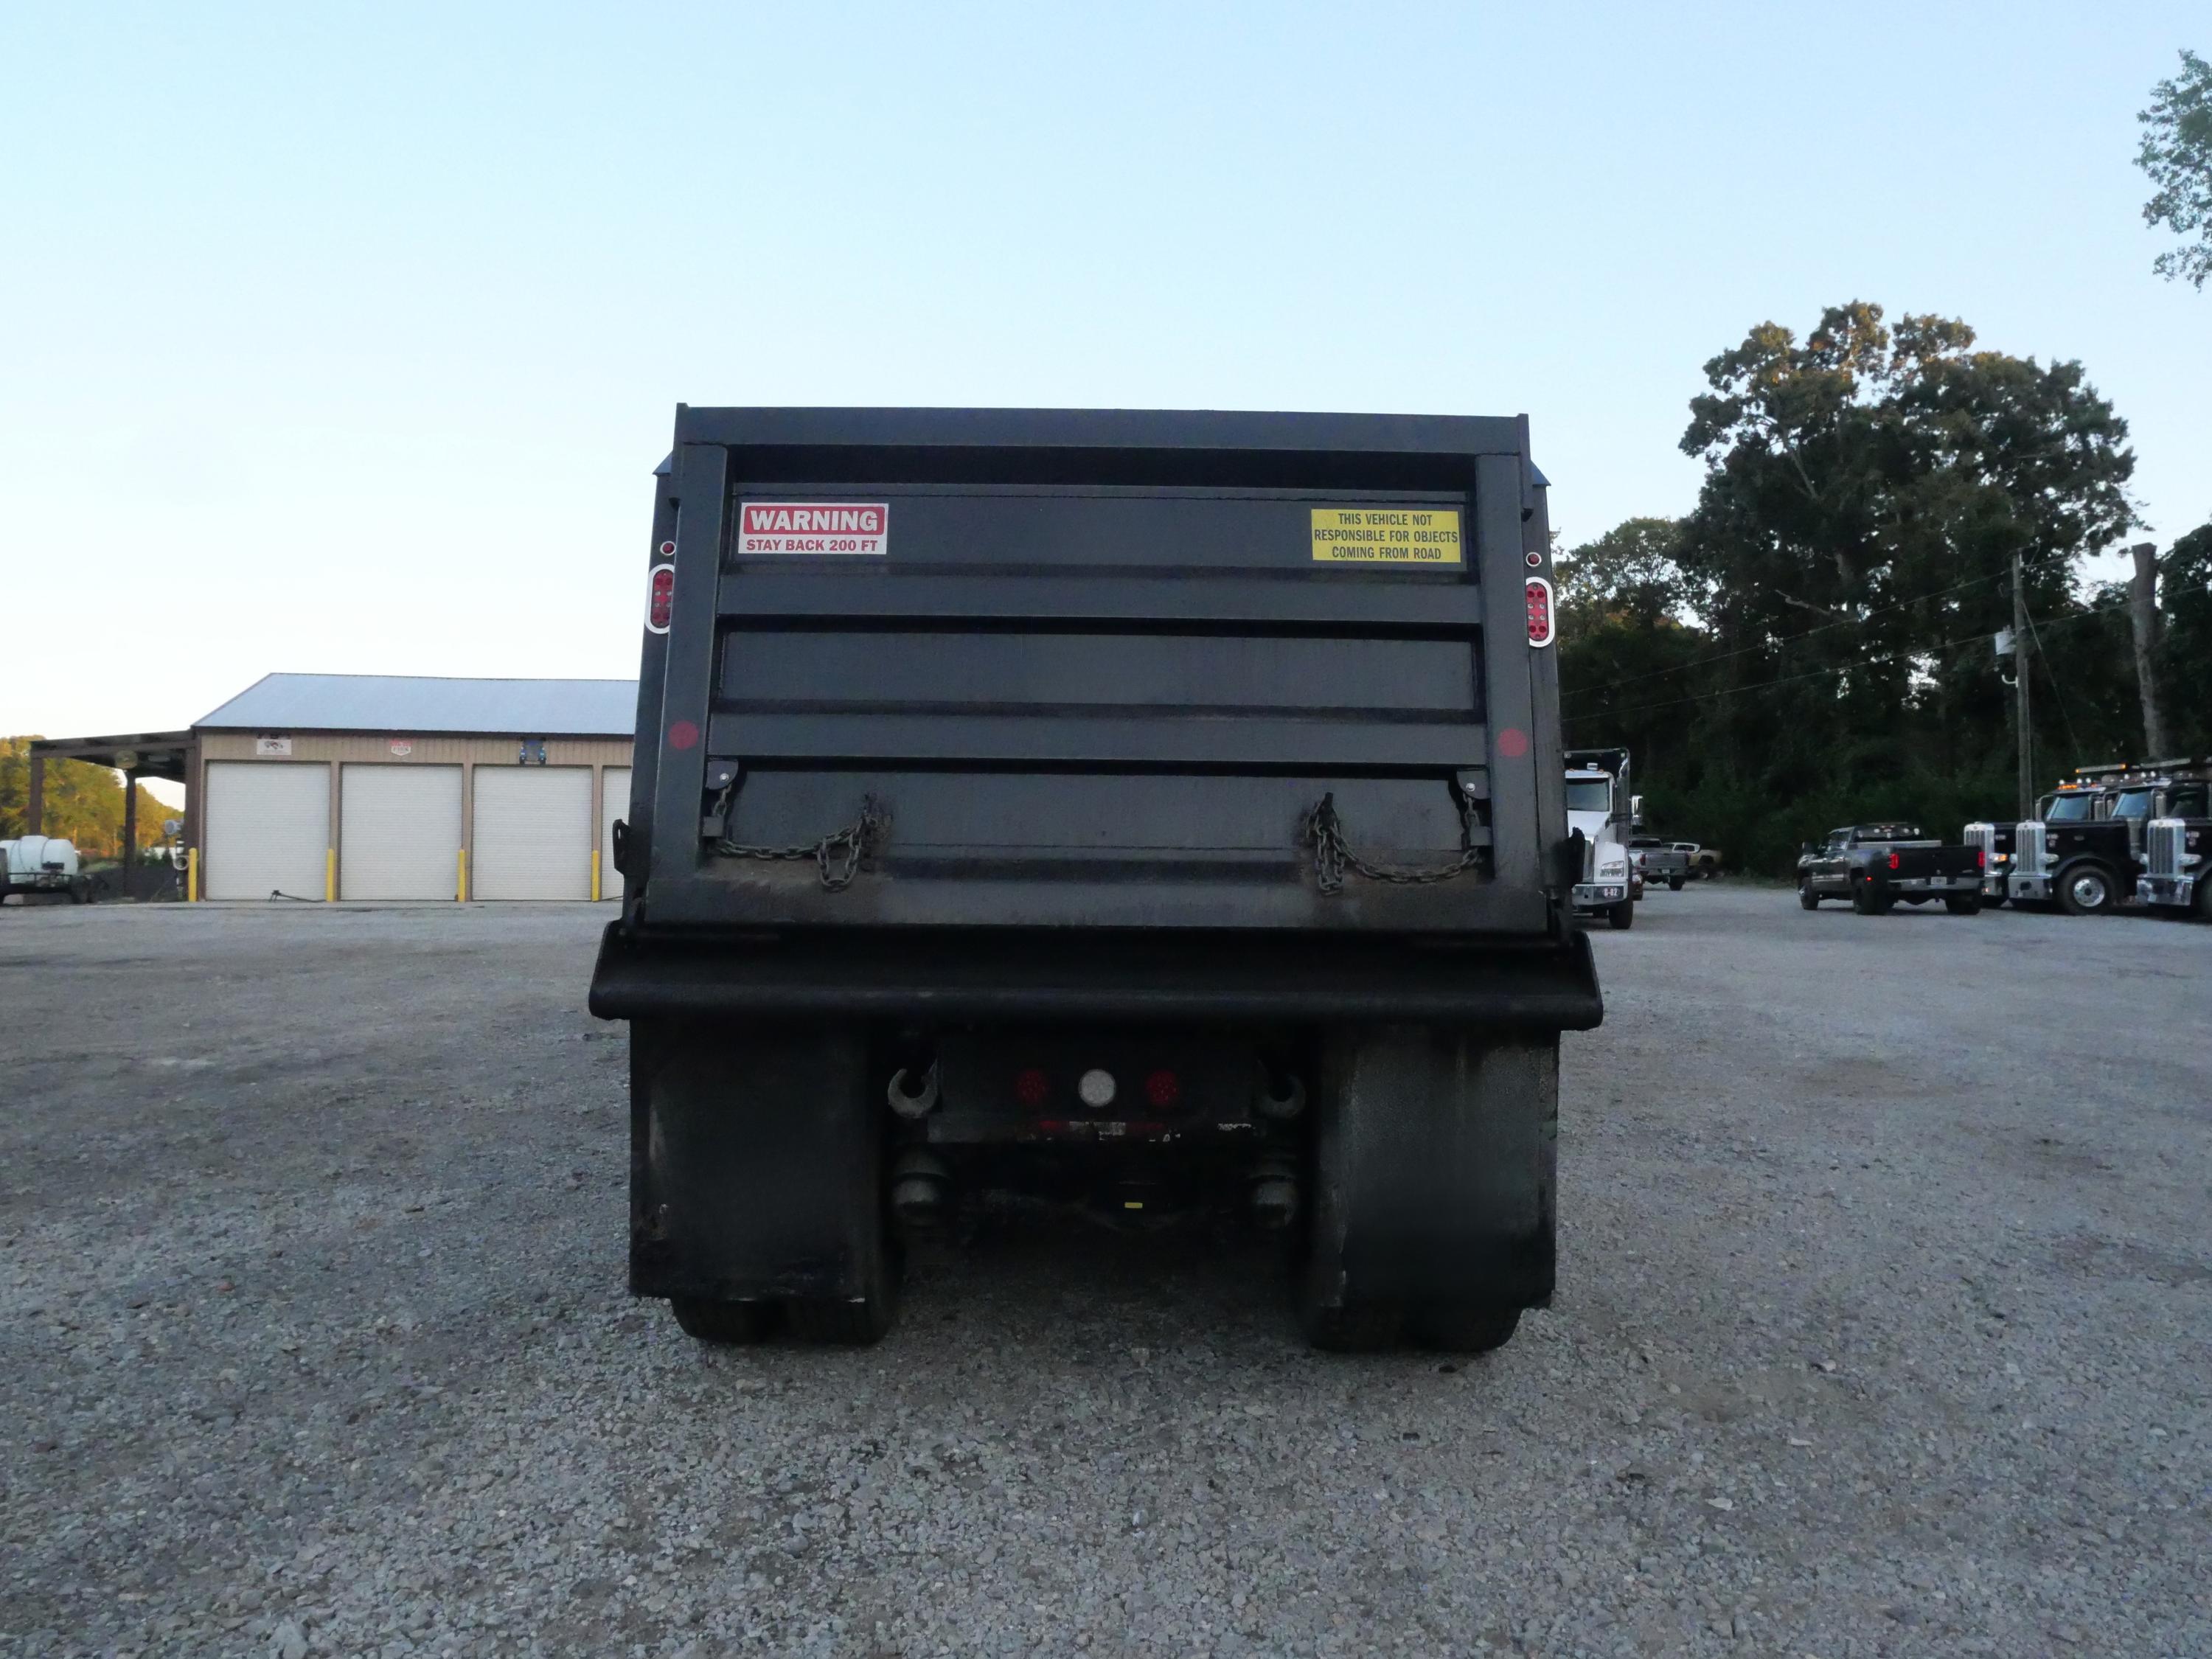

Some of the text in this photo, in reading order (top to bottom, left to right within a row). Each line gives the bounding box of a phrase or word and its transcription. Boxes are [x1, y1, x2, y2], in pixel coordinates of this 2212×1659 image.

[750, 510, 877, 531] WARNING
[1338, 513, 1432, 526] THIS VEHICLE NOT
[1315, 529, 1458, 543] RESPONSIBLE FOR OBJECTS
[746, 539, 878, 551] STAY BACK 200 FT
[1332, 546, 1441, 560] COMING FROM ROAD
